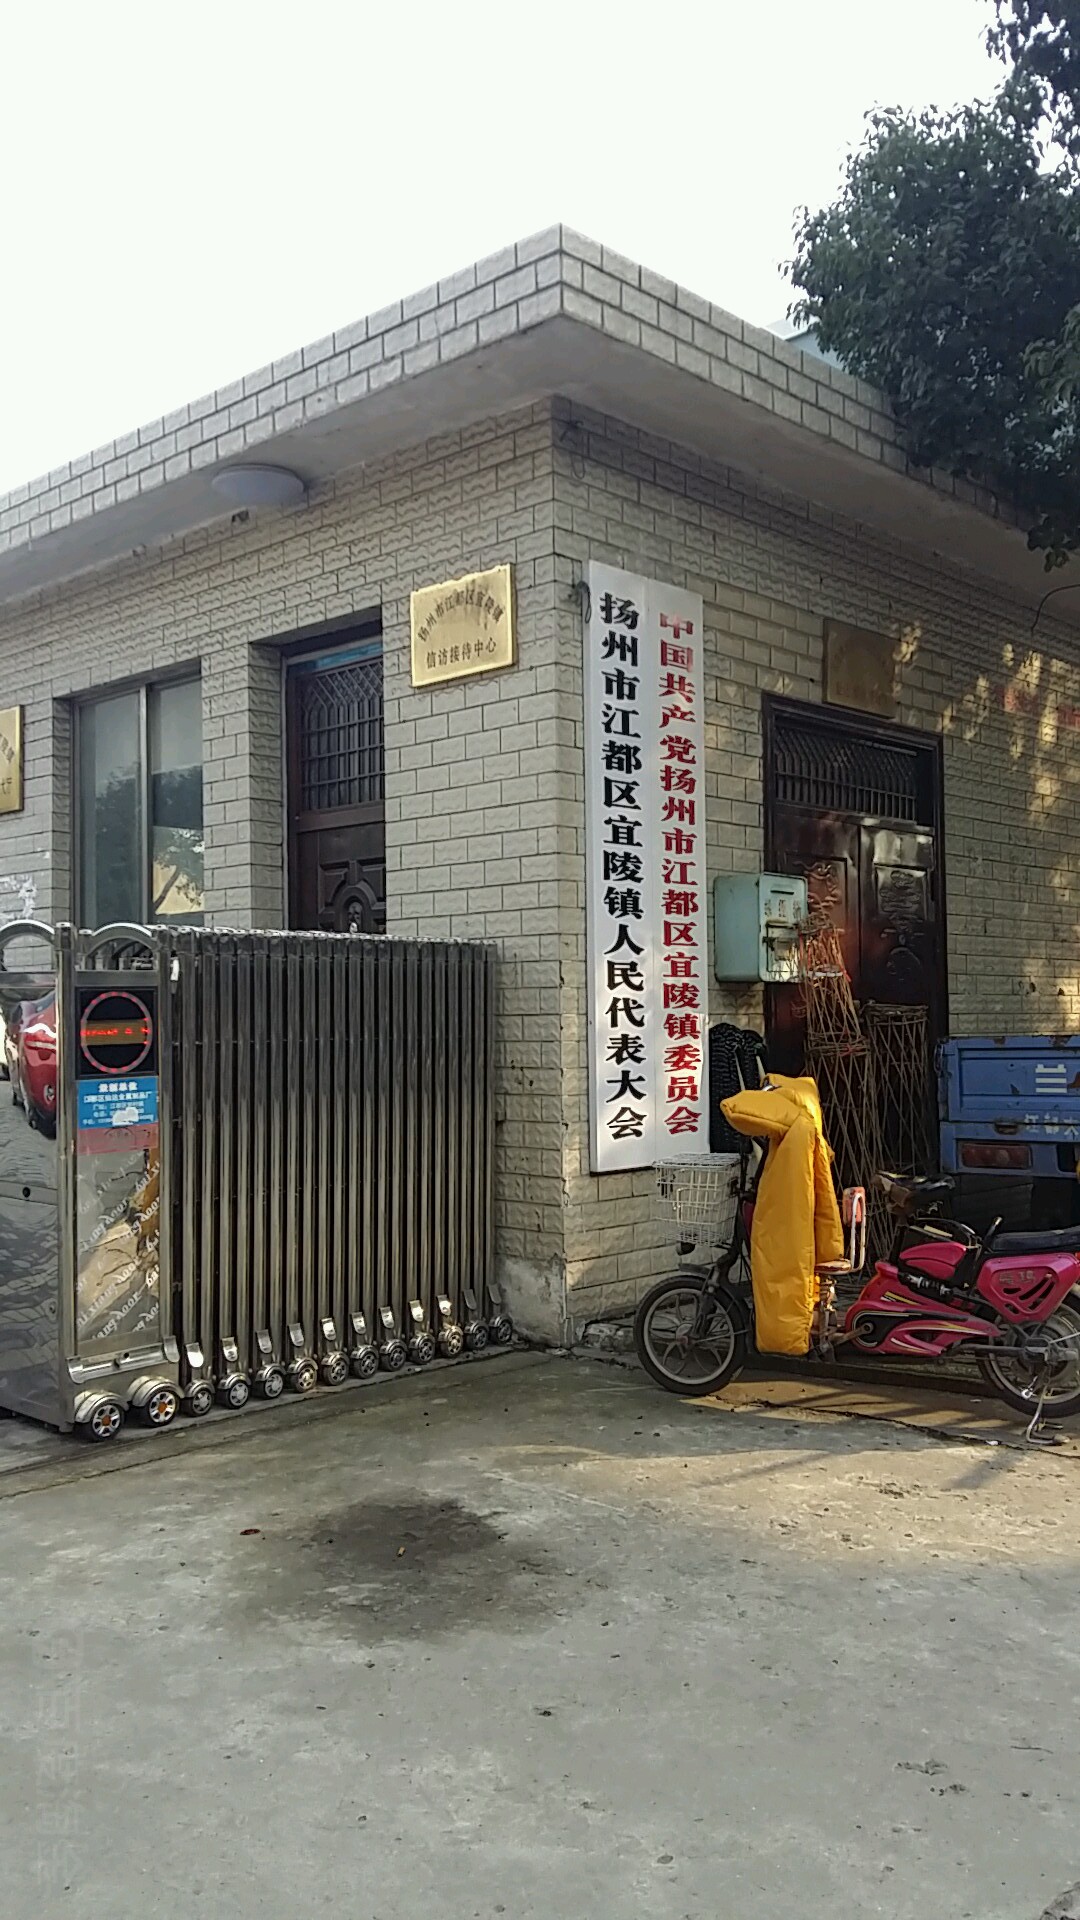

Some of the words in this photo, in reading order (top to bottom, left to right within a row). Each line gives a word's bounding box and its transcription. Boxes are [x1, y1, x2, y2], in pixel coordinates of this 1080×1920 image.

[427, 636, 497, 669] 信访接待中心
[599, 591, 647, 1141] 扬州市江都区宜陵镇人民代表大会
[658, 611, 703, 1136] 中国共产党扬州市江都区宜陵镇委员会
